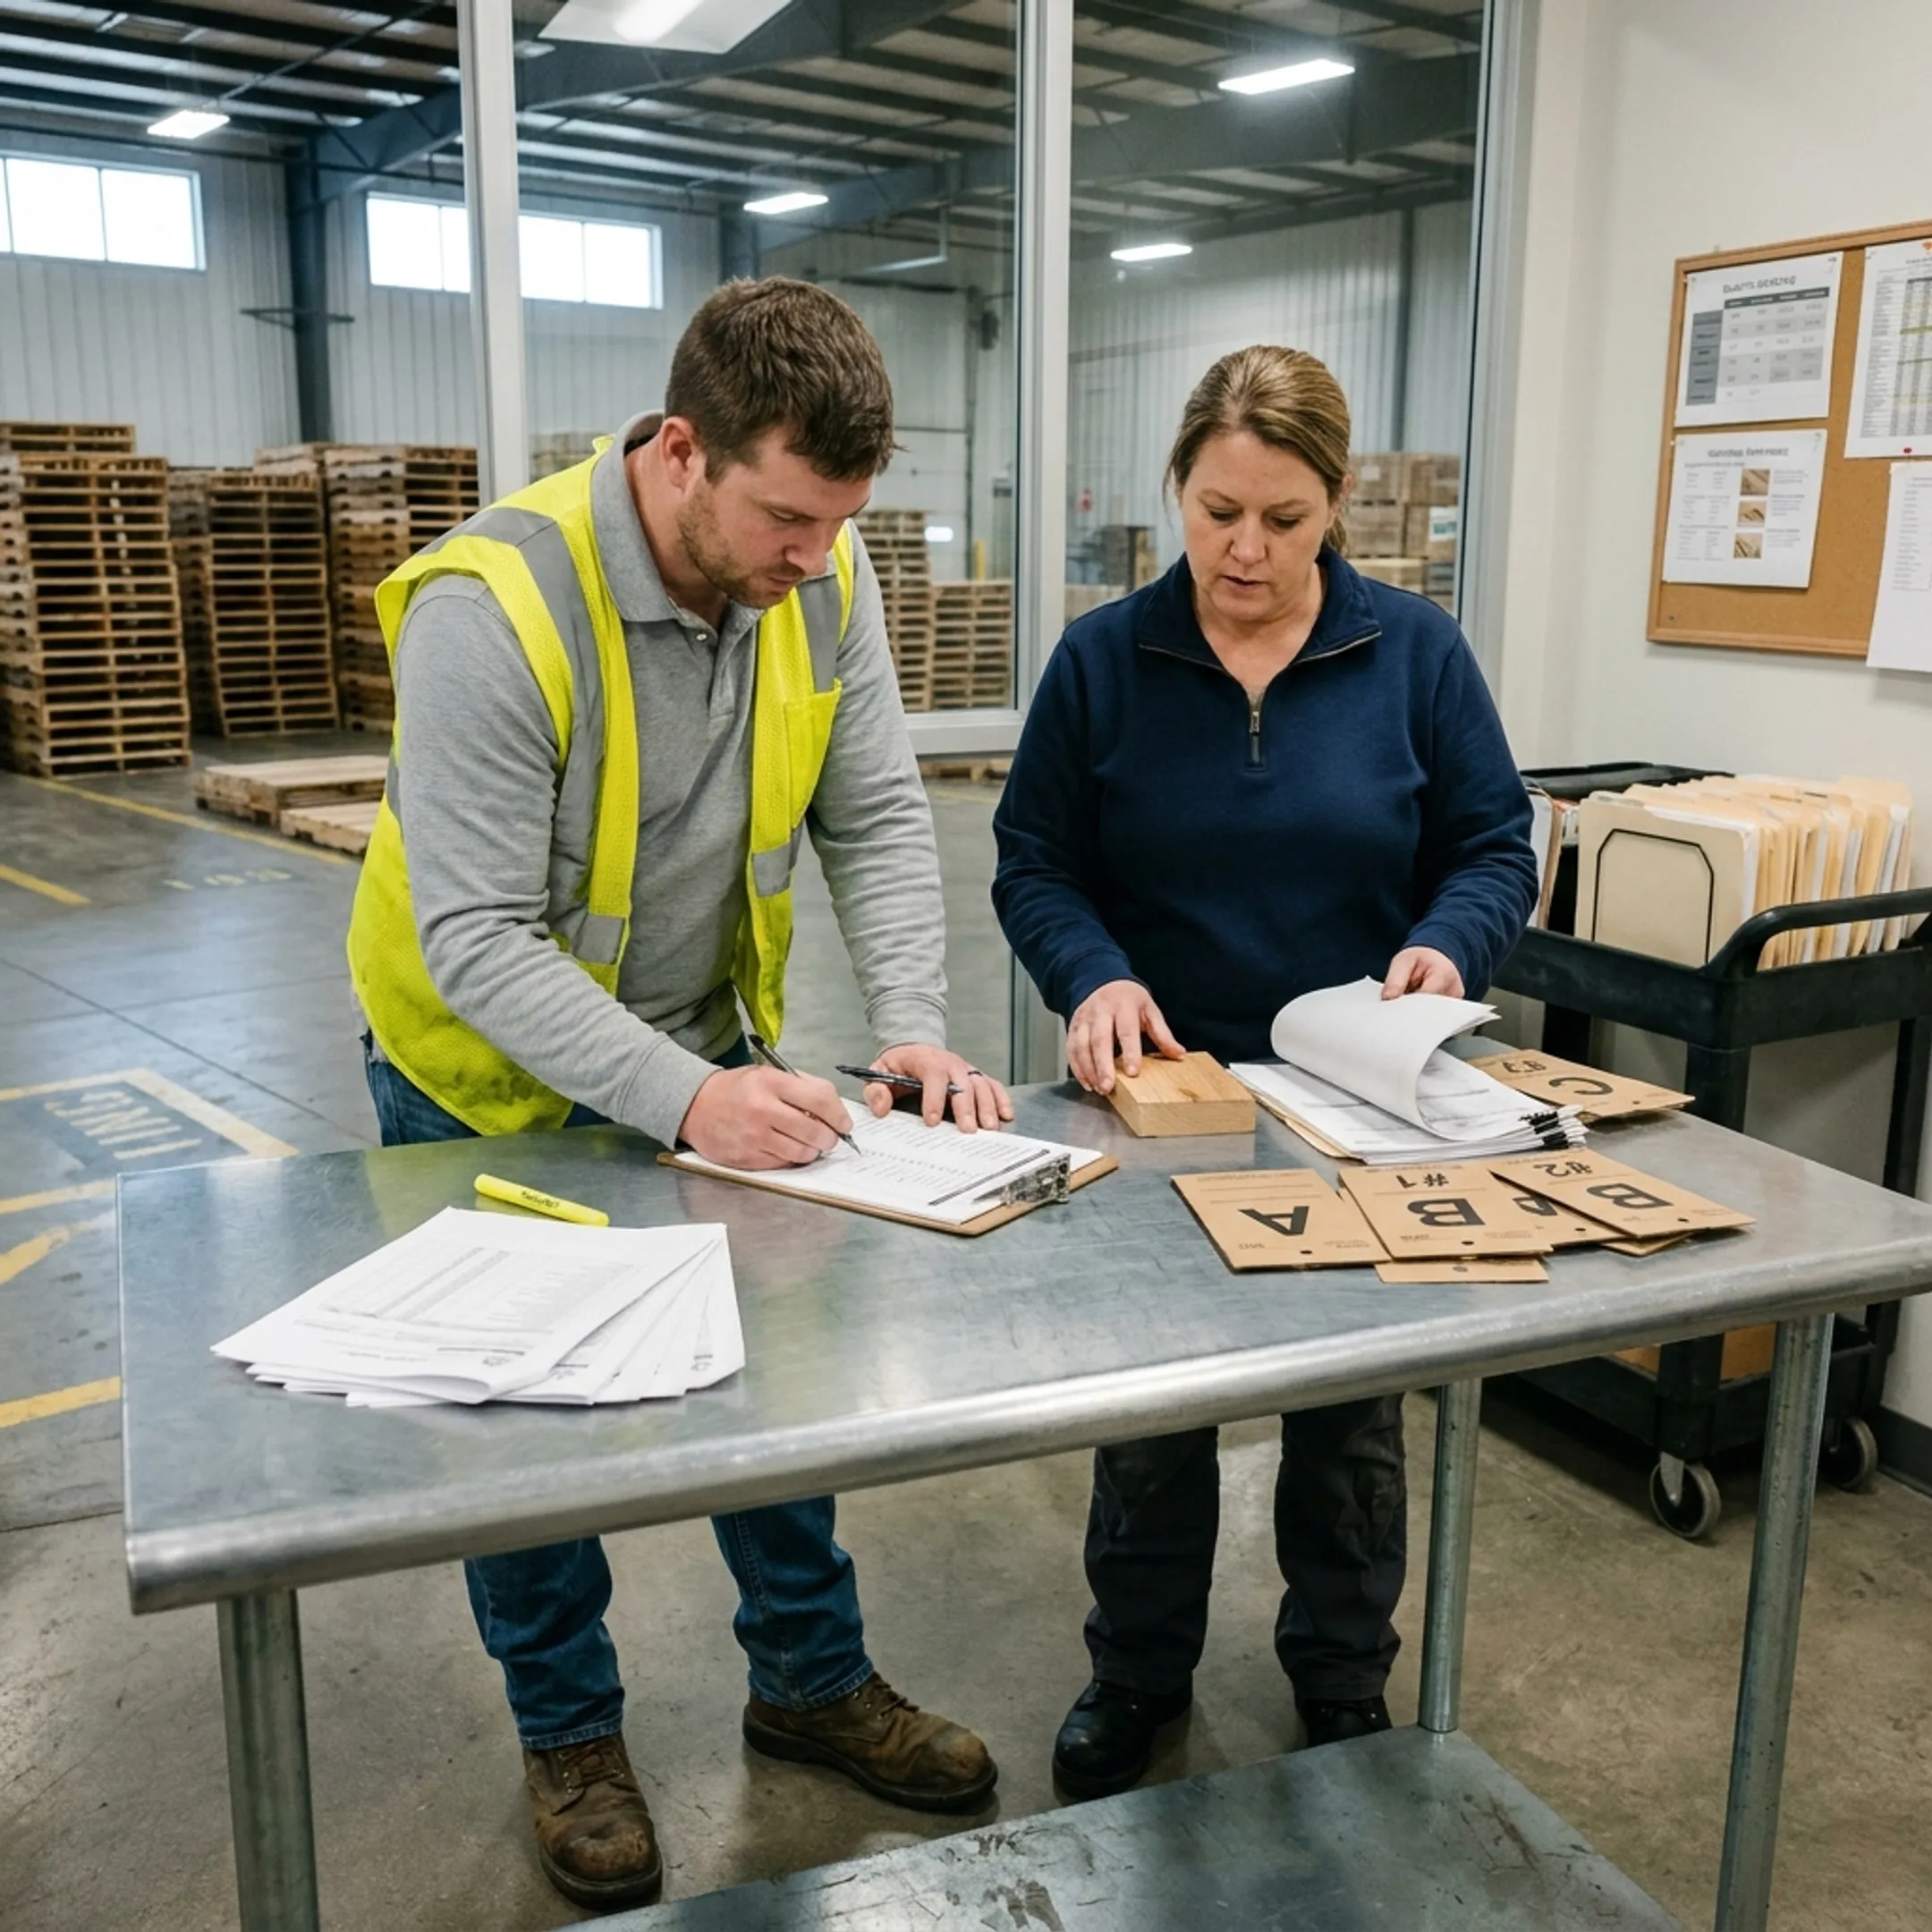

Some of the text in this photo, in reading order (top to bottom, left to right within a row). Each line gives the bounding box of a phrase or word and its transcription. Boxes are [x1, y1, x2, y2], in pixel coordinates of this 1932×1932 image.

[1548, 1076, 1614, 1097] C
[1394, 1173, 1449, 1189] #1
[1587, 1182, 1674, 1209] B
[1238, 1205, 1310, 1237] A
[1407, 1198, 1486, 1227] B
